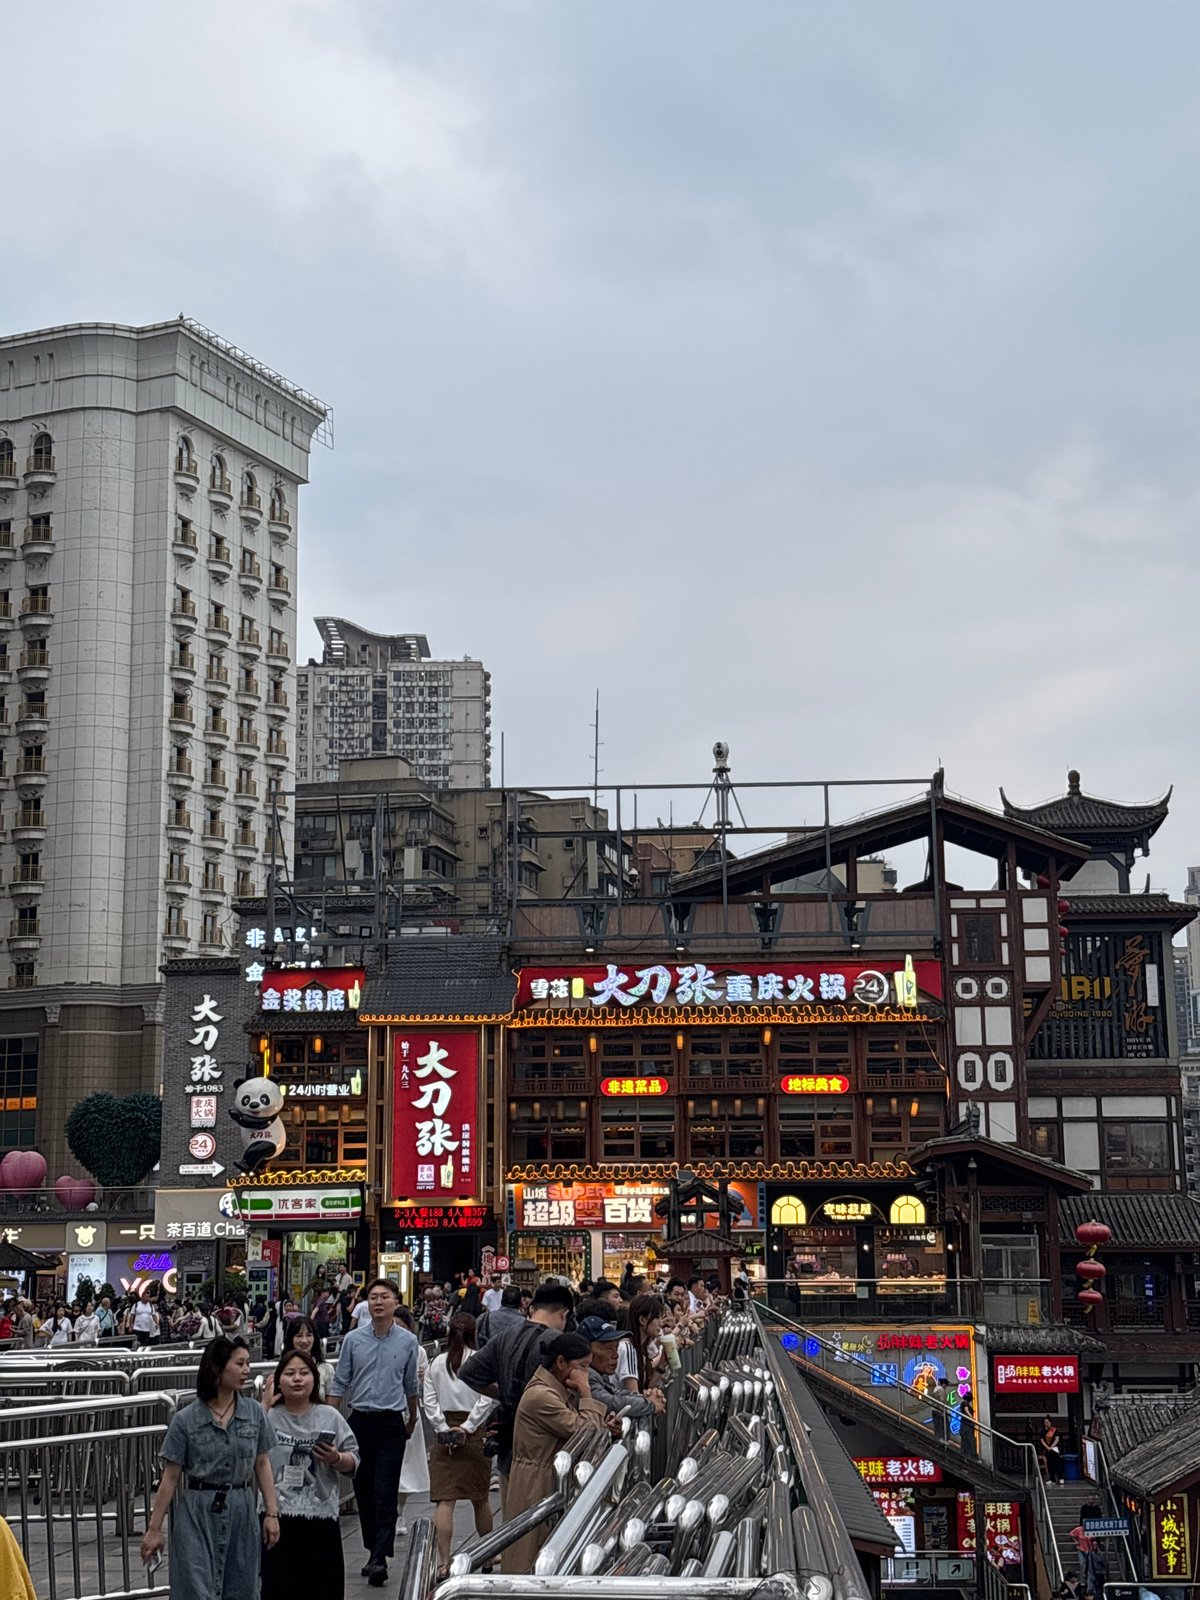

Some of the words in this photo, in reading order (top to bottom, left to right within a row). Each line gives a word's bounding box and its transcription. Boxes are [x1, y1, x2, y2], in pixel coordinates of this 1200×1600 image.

[530, 977, 570, 999] 雪花
[589, 963, 723, 1007] 大刀张
[725, 972, 847, 1001] 重庆火锅
[262, 987, 345, 1011] 金奖锅底
[187, 994, 224, 1082] 大刀张
[400, 1041, 410, 1089] 始于一九八三
[288, 1083, 350, 1096] 24小时营业
[607, 1079, 662, 1094] 非遗菜品
[787, 1077, 842, 1092] 地标美食
[411, 1040, 460, 1157] 大刀张
[190, 1139, 208, 1150] 24
[523, 1186, 547, 1200] 山城
[548, 1185, 605, 1200] SUPER
[277, 1197, 317, 1210] 优客家
[523, 1200, 575, 1226] 超级
[575, 1200, 603, 1210] GIFT
[603, 1197, 652, 1223] 百货
[166, 1222, 212, 1237] 茶百道
[133, 1252, 173, 1271] Hello
[1160, 1500, 1181, 1573] 小城故事
